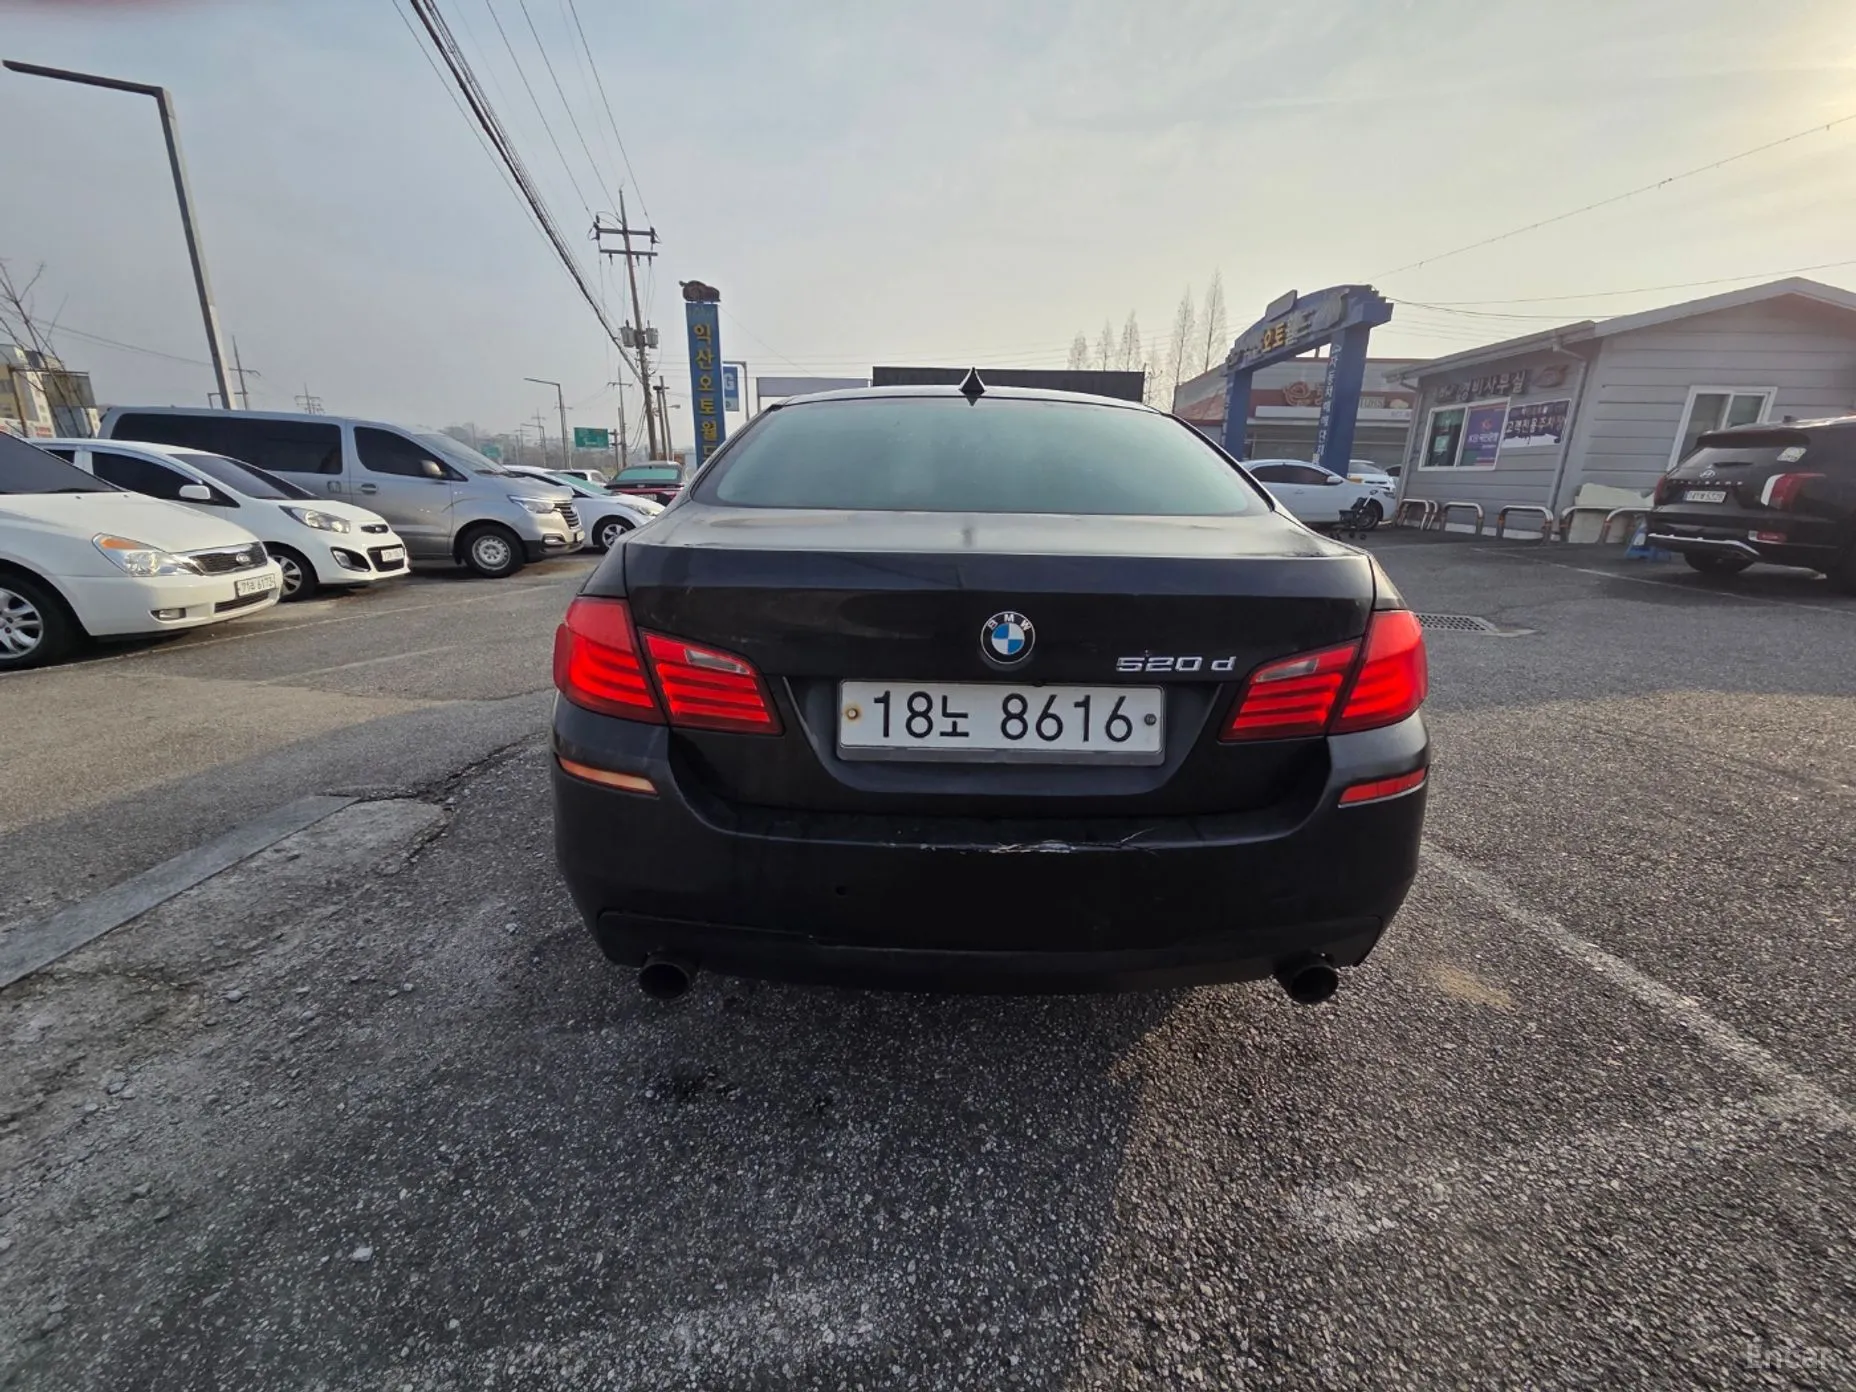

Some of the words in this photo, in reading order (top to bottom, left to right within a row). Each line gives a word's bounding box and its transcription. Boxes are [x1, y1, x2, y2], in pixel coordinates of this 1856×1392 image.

[987, 613, 1032, 631] BMW
[1116, 656, 1203, 672] 520
[1211, 656, 1237, 671] d
[872, 690, 970, 739] 18노
[1000, 693, 1134, 743] 8616
